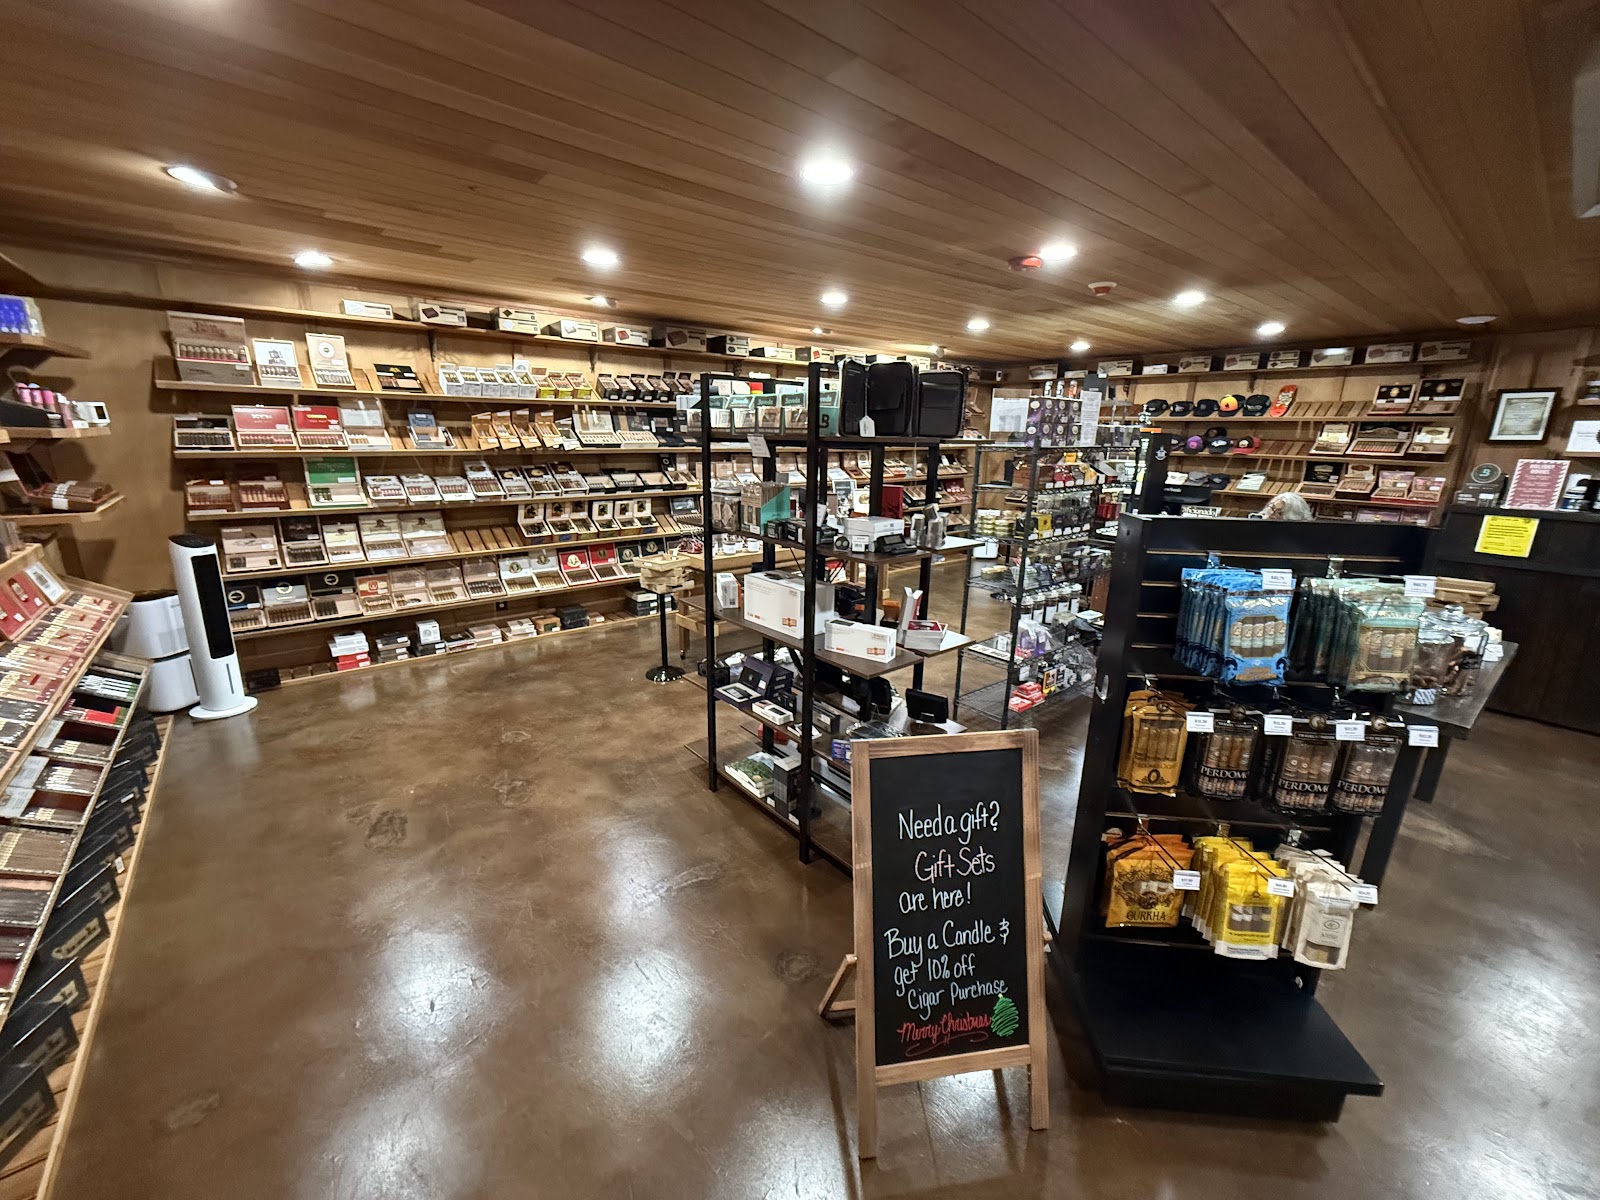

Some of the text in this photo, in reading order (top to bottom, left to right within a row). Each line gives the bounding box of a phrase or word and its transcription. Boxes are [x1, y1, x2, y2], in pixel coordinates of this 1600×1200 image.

[1337, 780, 1387, 794] PERDOM
[899, 801, 999, 844] Need a gift?
[915, 846, 996, 884] Gift Sets
[899, 882, 970, 913] are here!
[1126, 910, 1166, 921] GURKHA
[884, 928, 923, 967] Buy
[928, 933, 939, 949] a
[943, 919, 995, 947] Candle
[895, 953, 975, 997] get 10% off
[908, 980, 1008, 1020] Cigar Purchase
[897, 1012, 992, 1044] Merry Christmas
